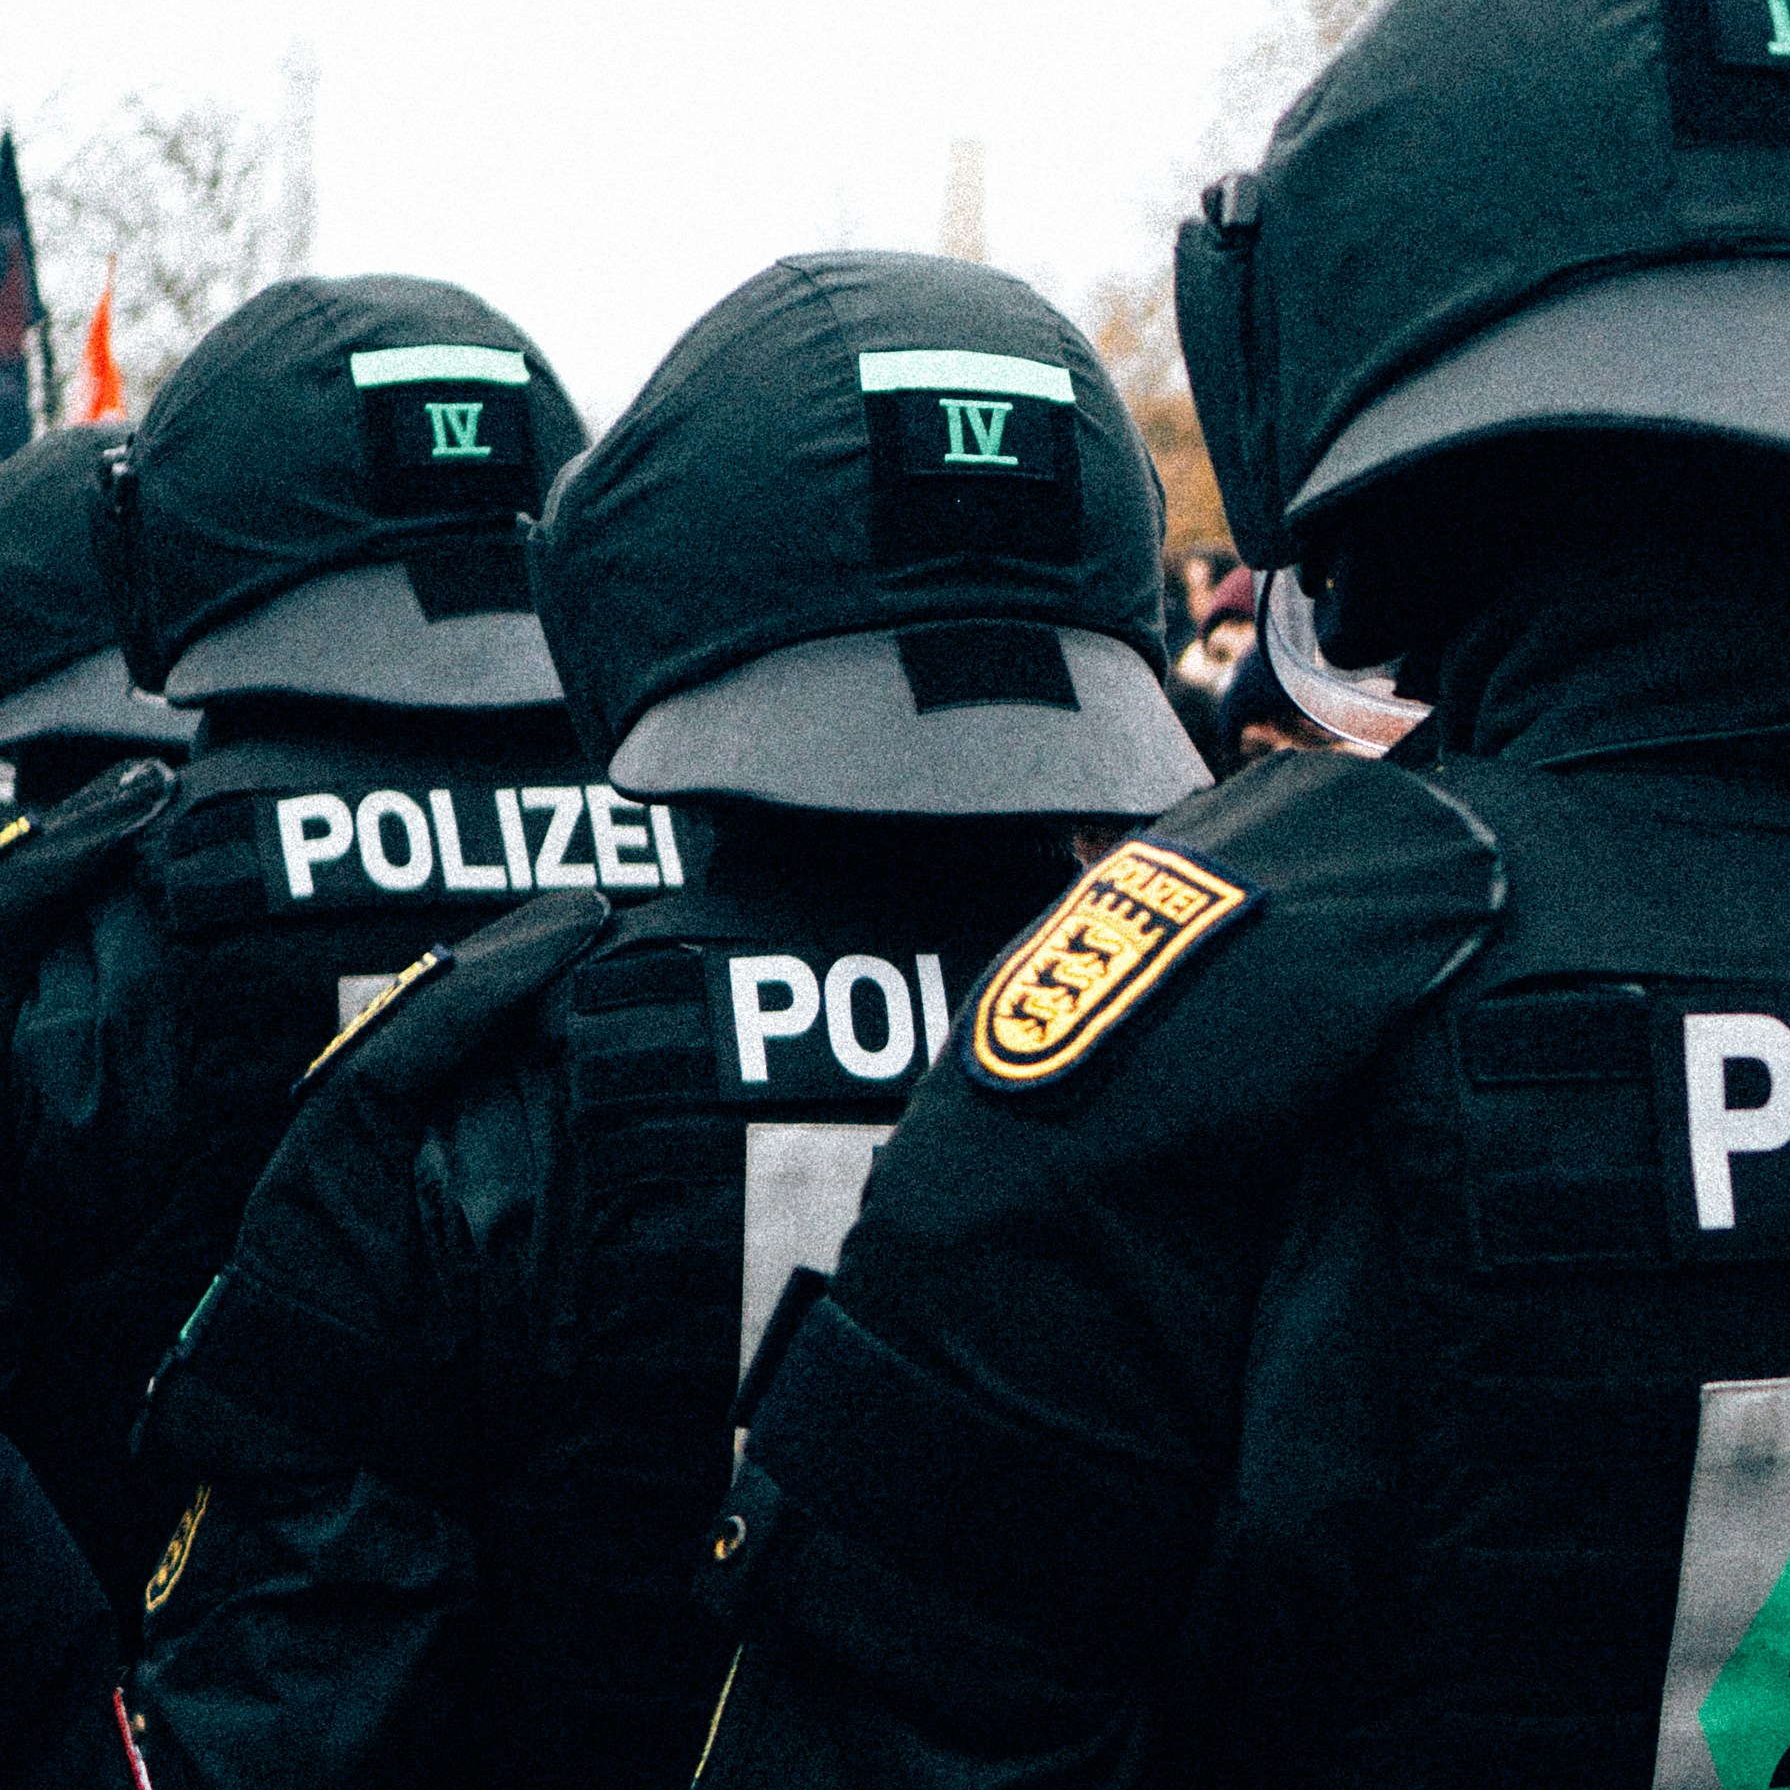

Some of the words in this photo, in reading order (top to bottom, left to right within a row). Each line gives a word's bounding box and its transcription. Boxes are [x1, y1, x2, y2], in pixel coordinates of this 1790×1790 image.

[425, 402, 492, 457] IV
[938, 398, 1019, 466] IV
[277, 783, 684, 898] POLIZEI
